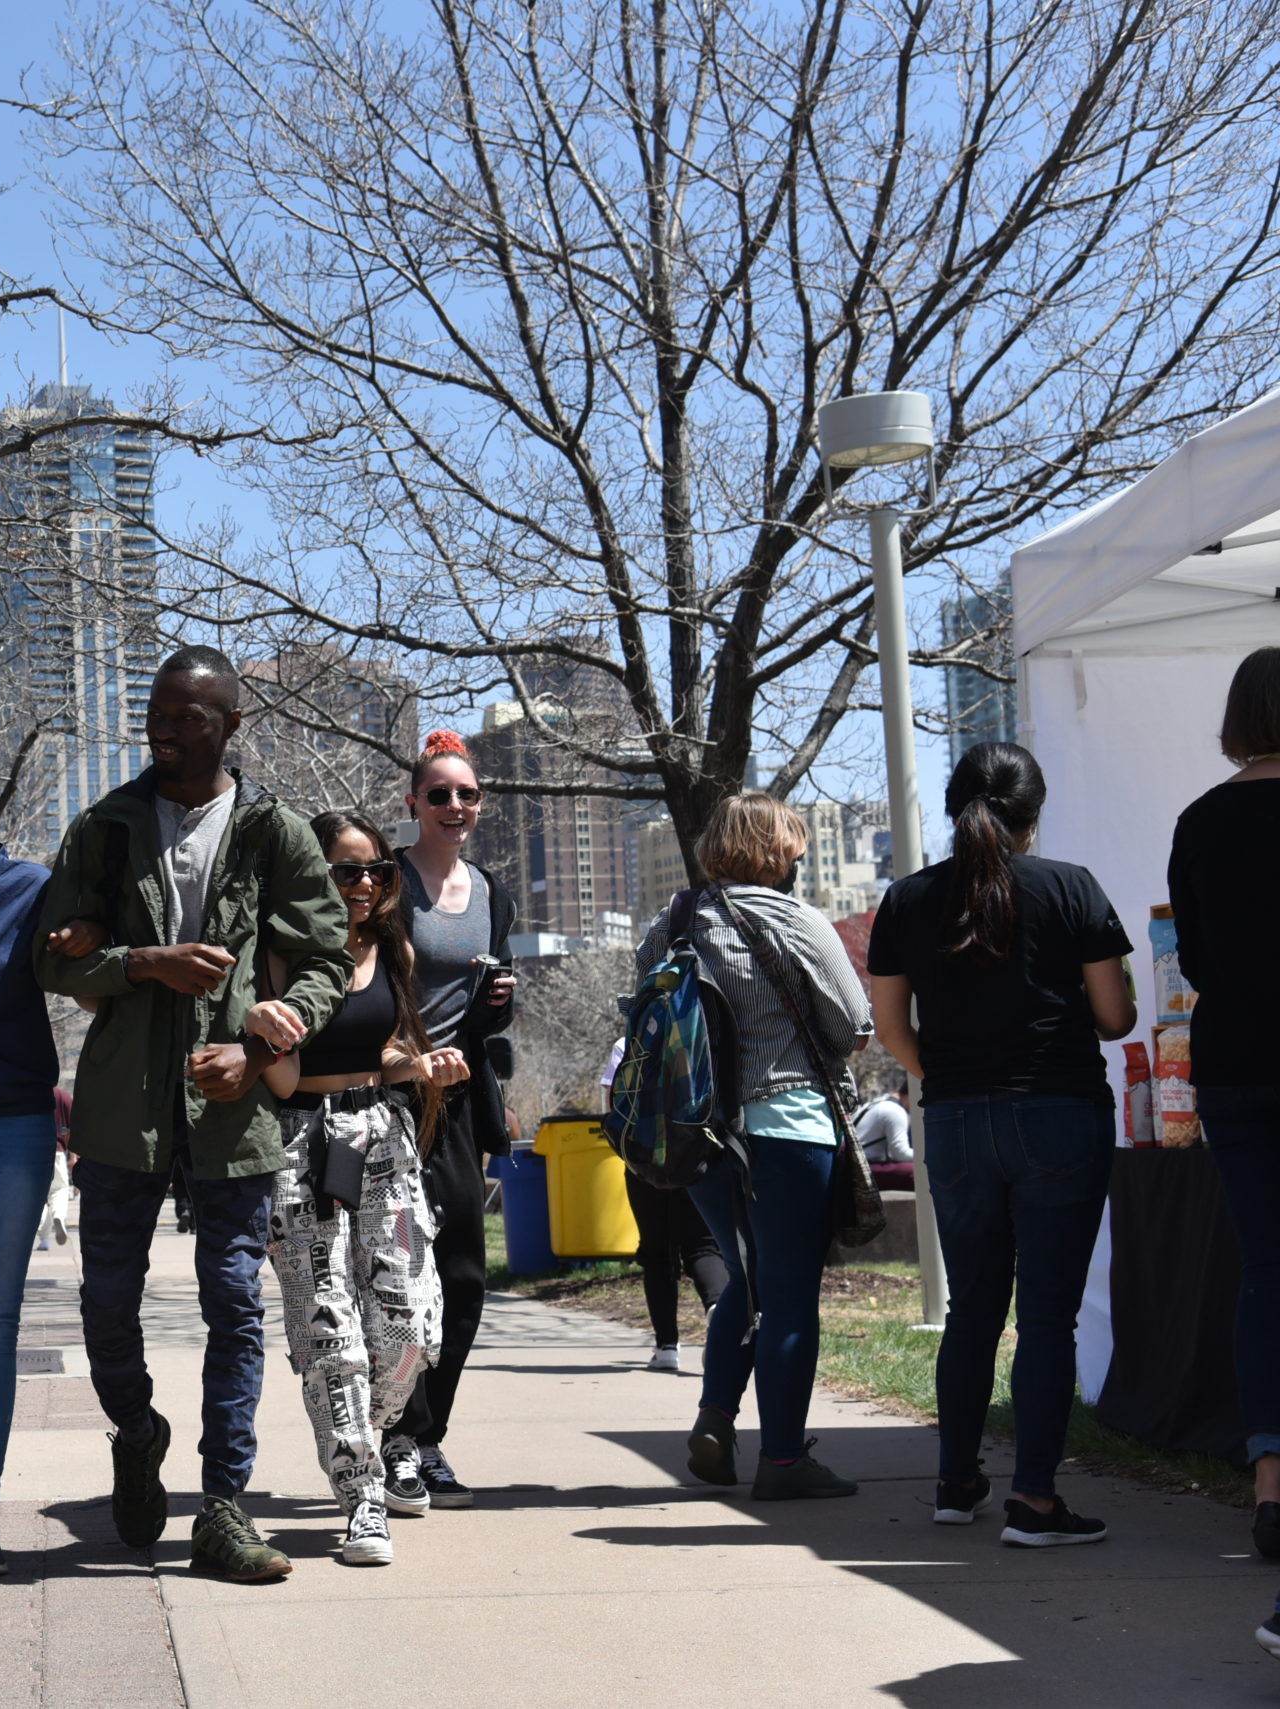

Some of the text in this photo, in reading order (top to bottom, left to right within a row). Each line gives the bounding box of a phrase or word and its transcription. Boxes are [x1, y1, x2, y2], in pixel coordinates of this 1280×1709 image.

[295, 1200, 317, 1216] OT
[361, 1201, 389, 1210] BEAU
[310, 1243, 332, 1291] GLAM
[317, 1292, 346, 1302] ECON
[382, 1339, 402, 1349] BEA
[328, 1377, 350, 1425] GLAM
